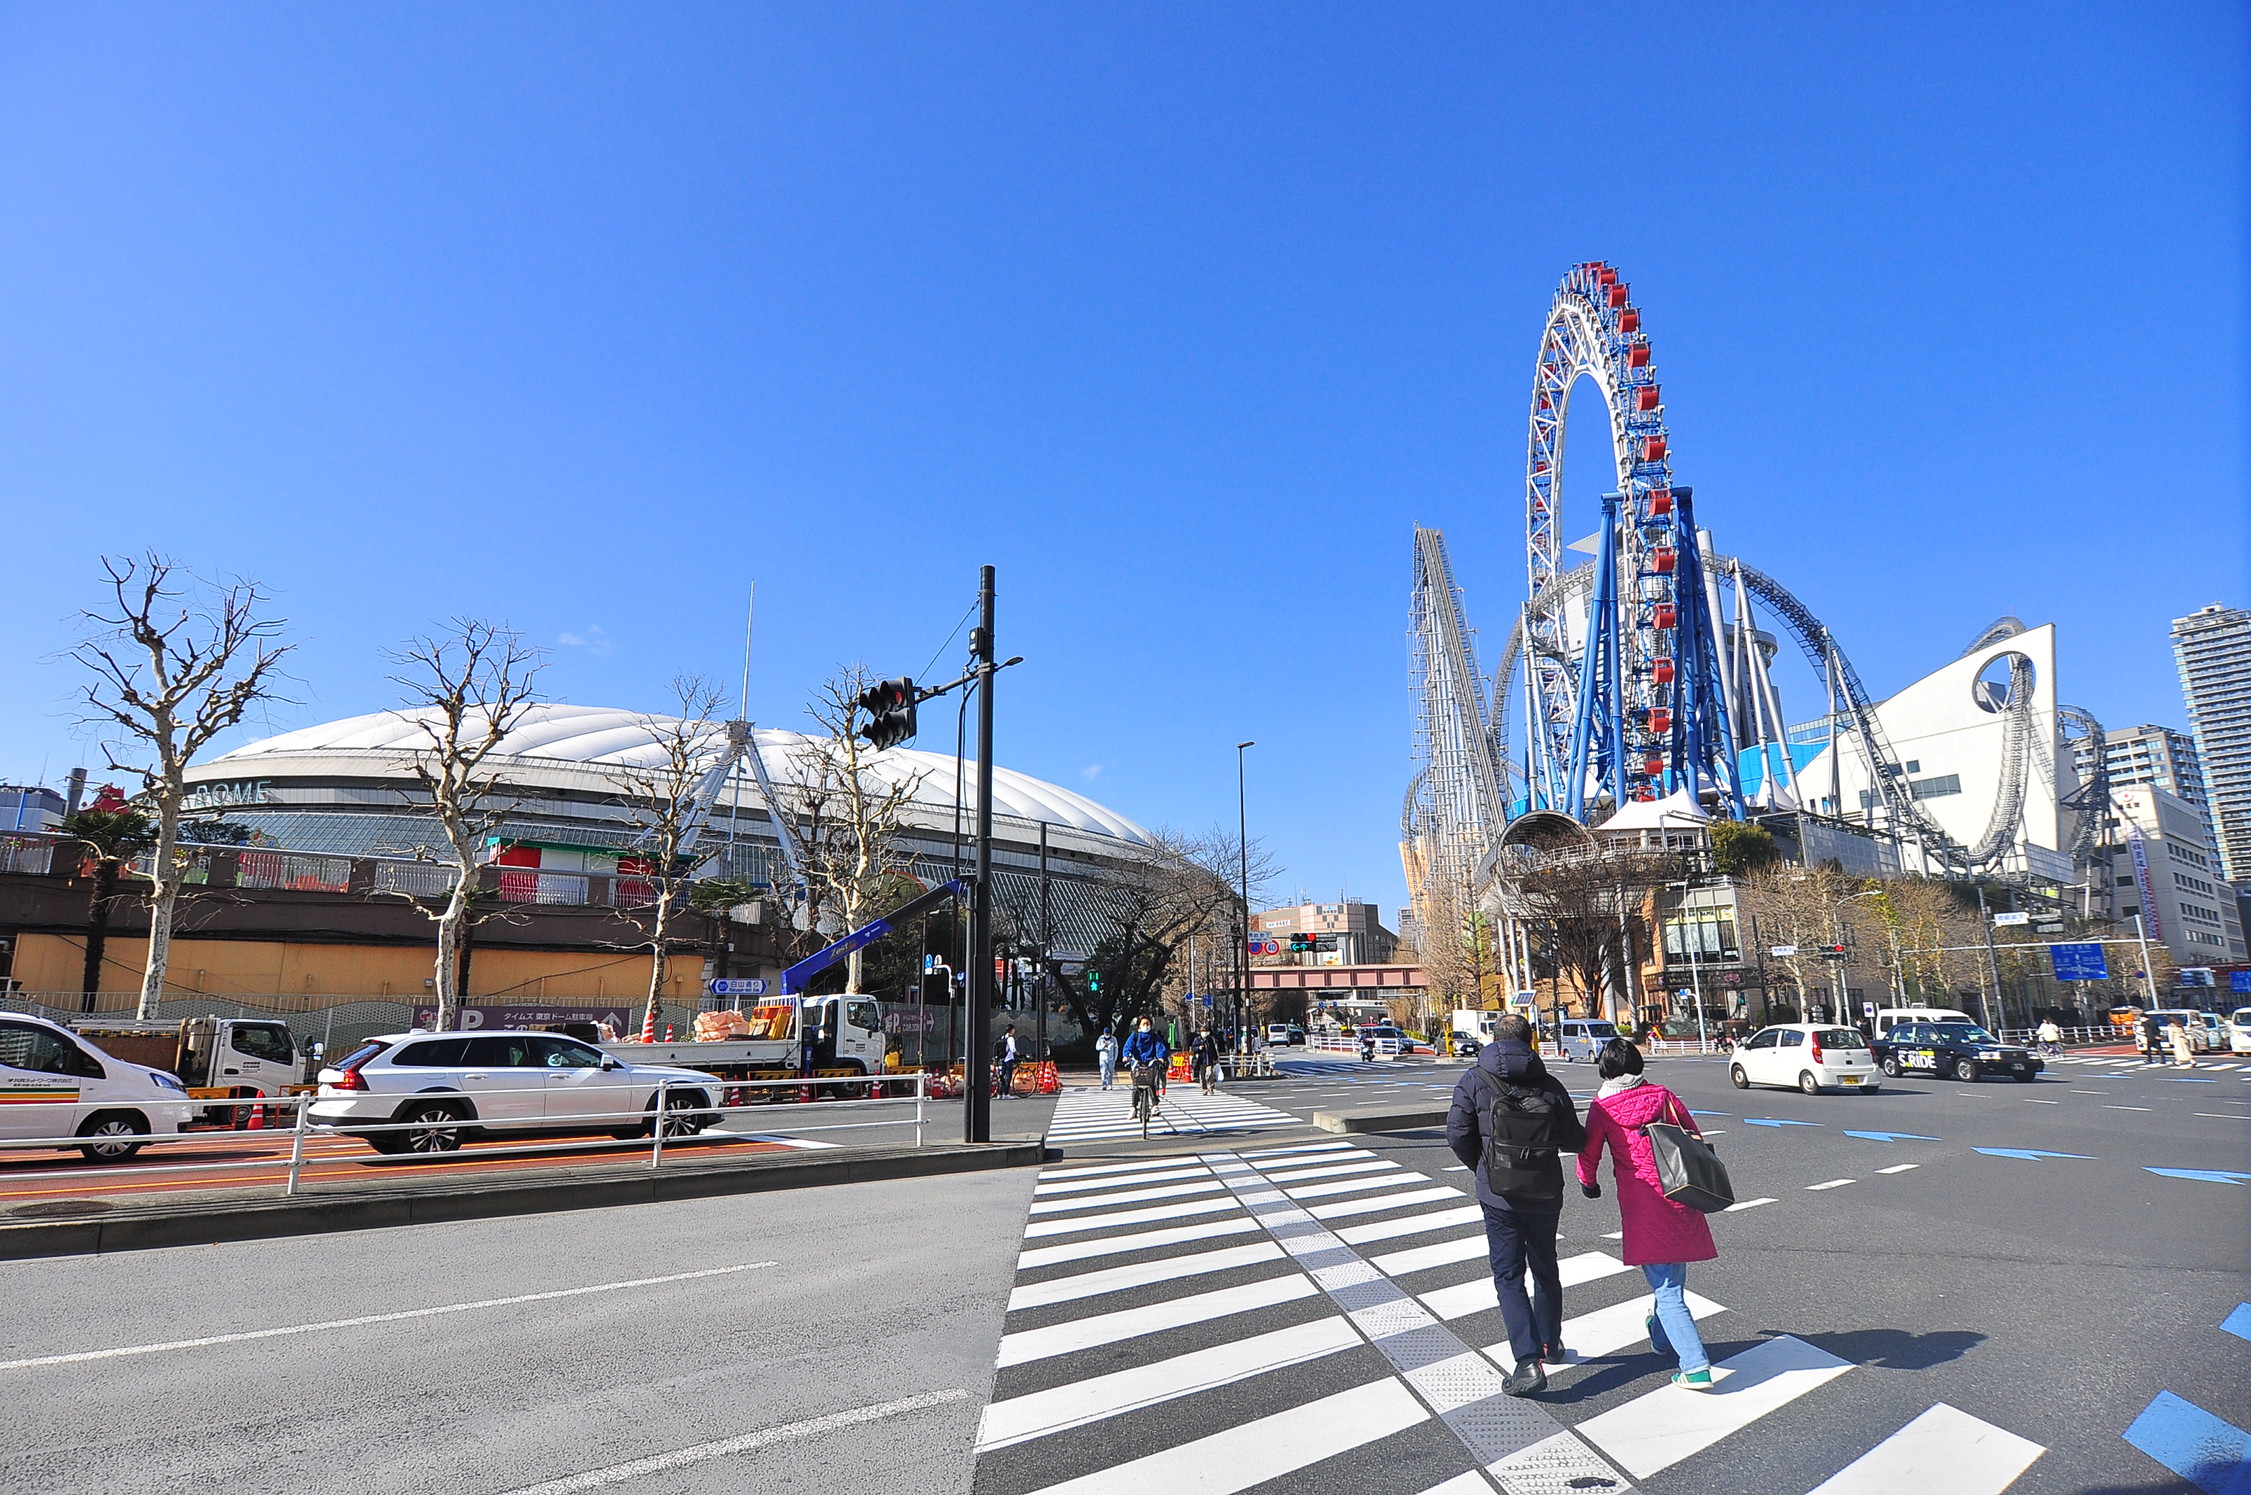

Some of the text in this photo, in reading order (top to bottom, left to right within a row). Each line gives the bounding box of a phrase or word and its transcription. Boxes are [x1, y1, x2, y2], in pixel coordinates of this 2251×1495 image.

[195, 779, 272, 808] DOME
[1268, 943, 1276, 951] 40
[461, 1010, 484, 1031] P
[504, 1012, 594, 1021] タイムズ 東京ドーム駐車場
[893, 1013, 900, 1034] P
[1898, 1054, 1938, 1069] S.RIDE
